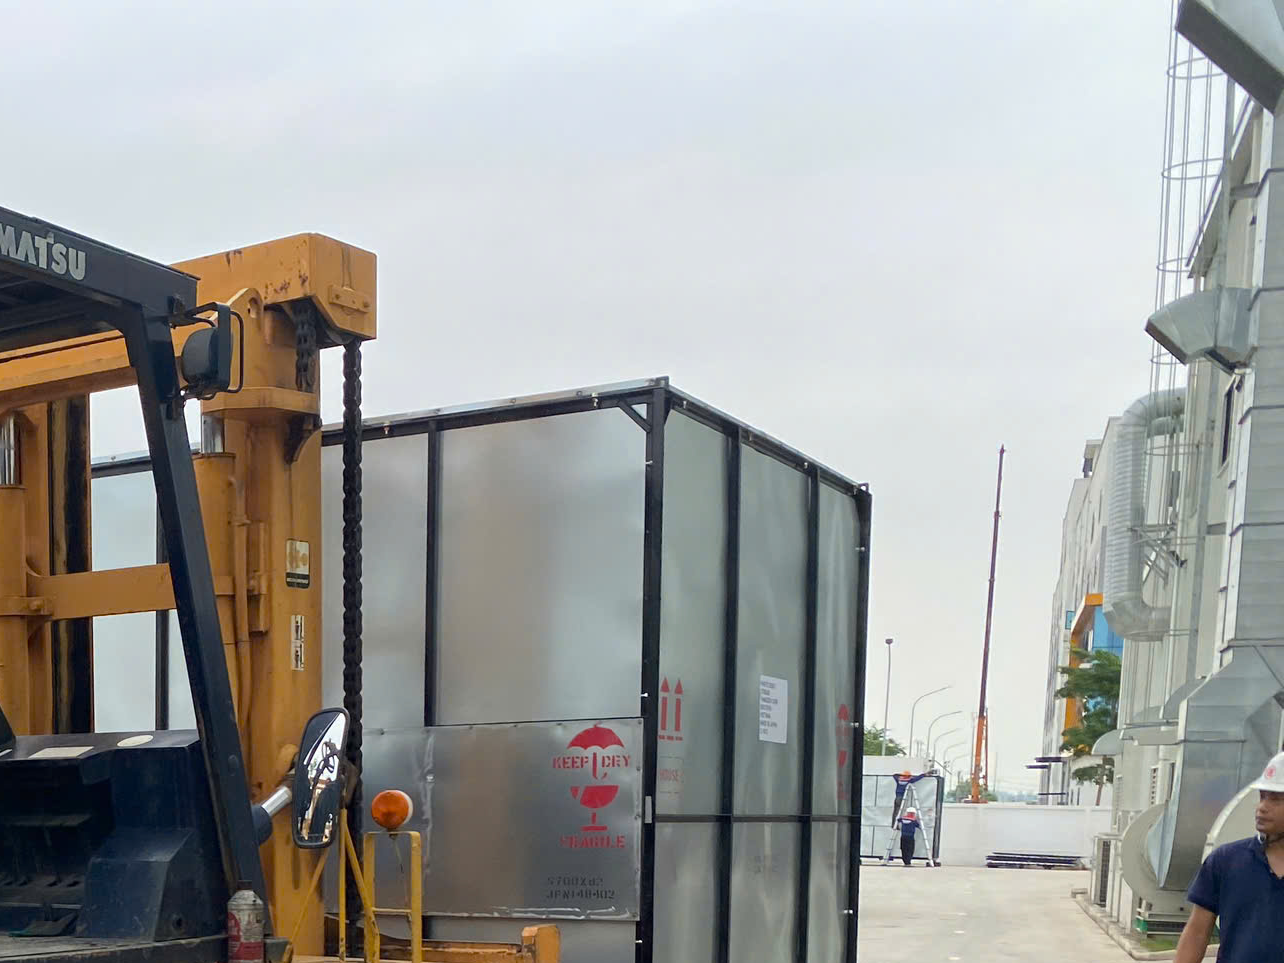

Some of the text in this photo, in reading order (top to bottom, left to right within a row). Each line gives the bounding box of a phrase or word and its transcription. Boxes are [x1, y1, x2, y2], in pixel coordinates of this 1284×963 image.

[552, 754, 631, 770] KEEP DRY
[559, 834, 626, 849] FRAGILE
